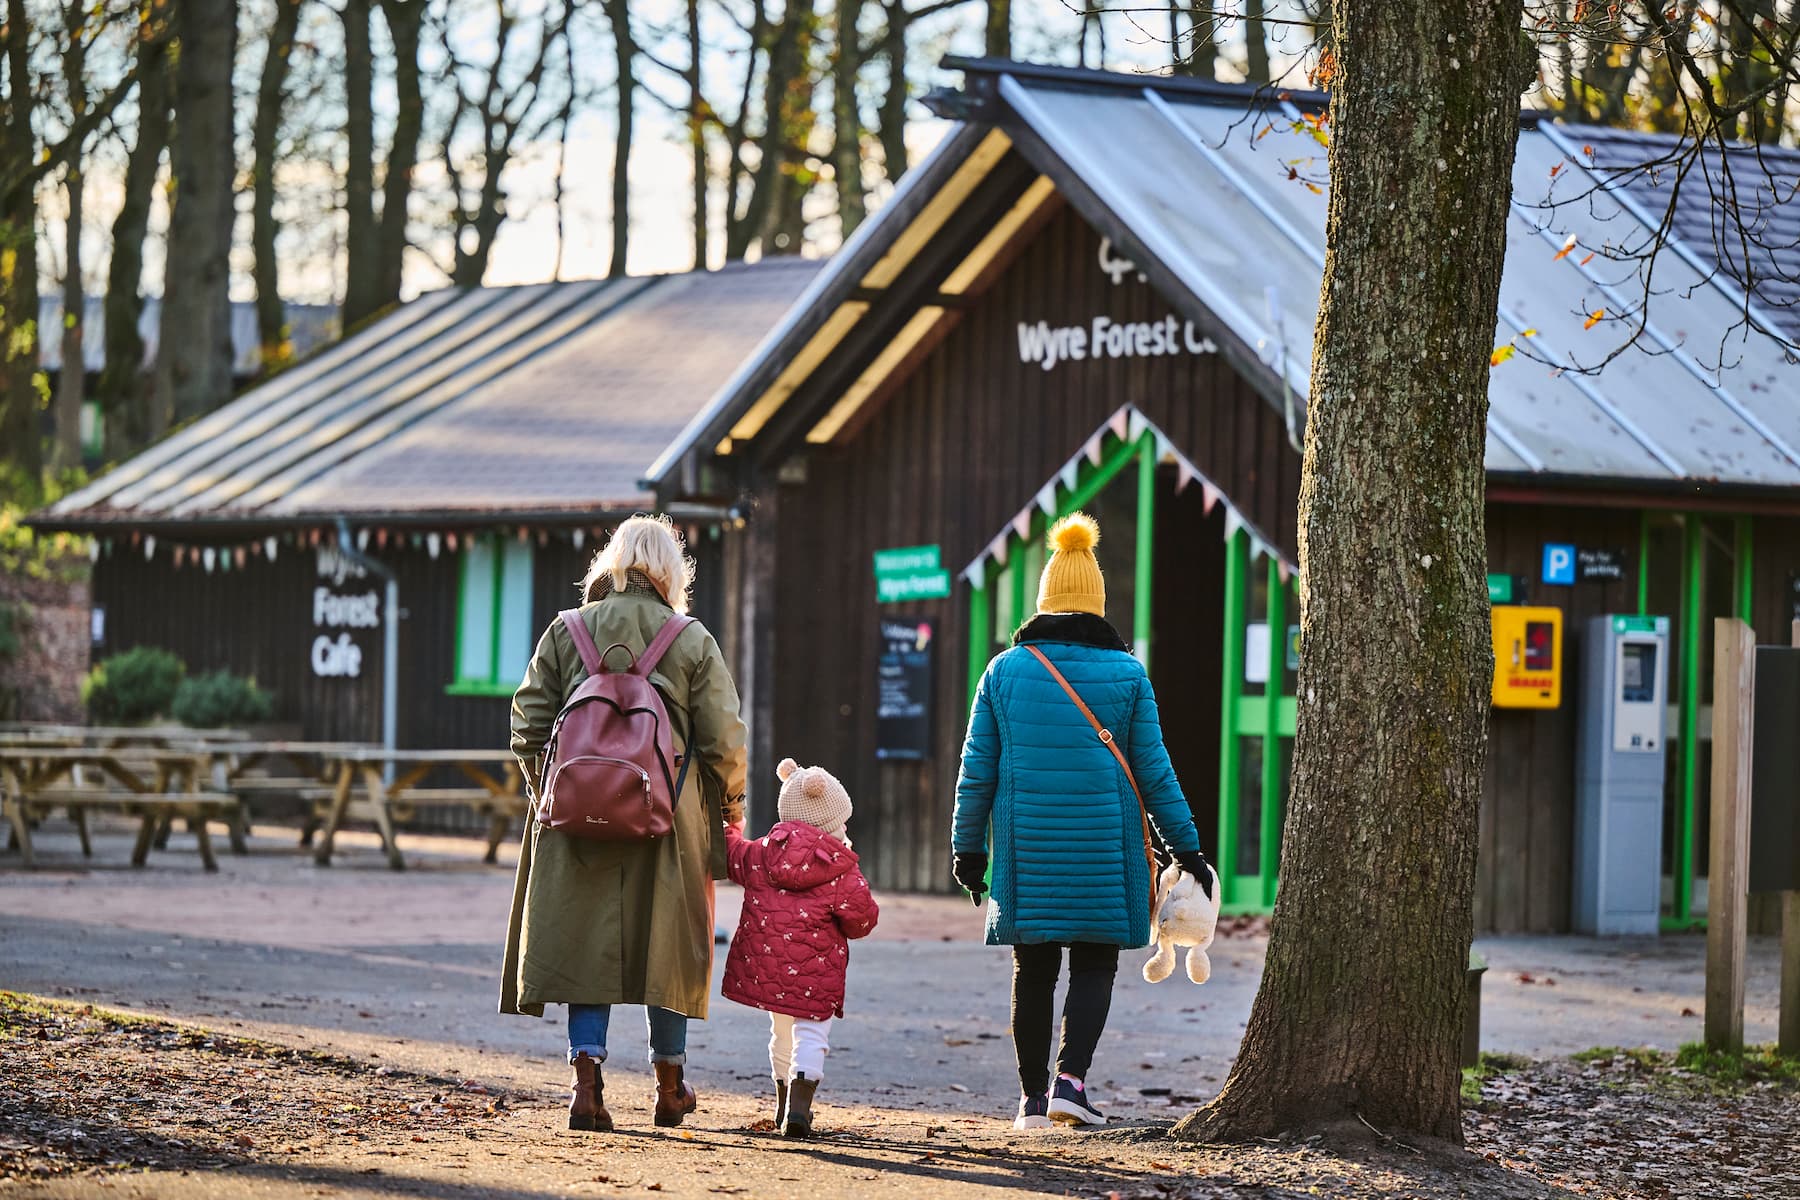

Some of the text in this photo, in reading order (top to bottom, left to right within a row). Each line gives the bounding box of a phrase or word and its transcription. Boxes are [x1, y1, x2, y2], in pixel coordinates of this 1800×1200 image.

[1017, 319, 1088, 371] Wyre
[1091, 314, 1180, 358] Forest
[1549, 550, 1570, 580] P
[313, 586, 379, 628] Forest
